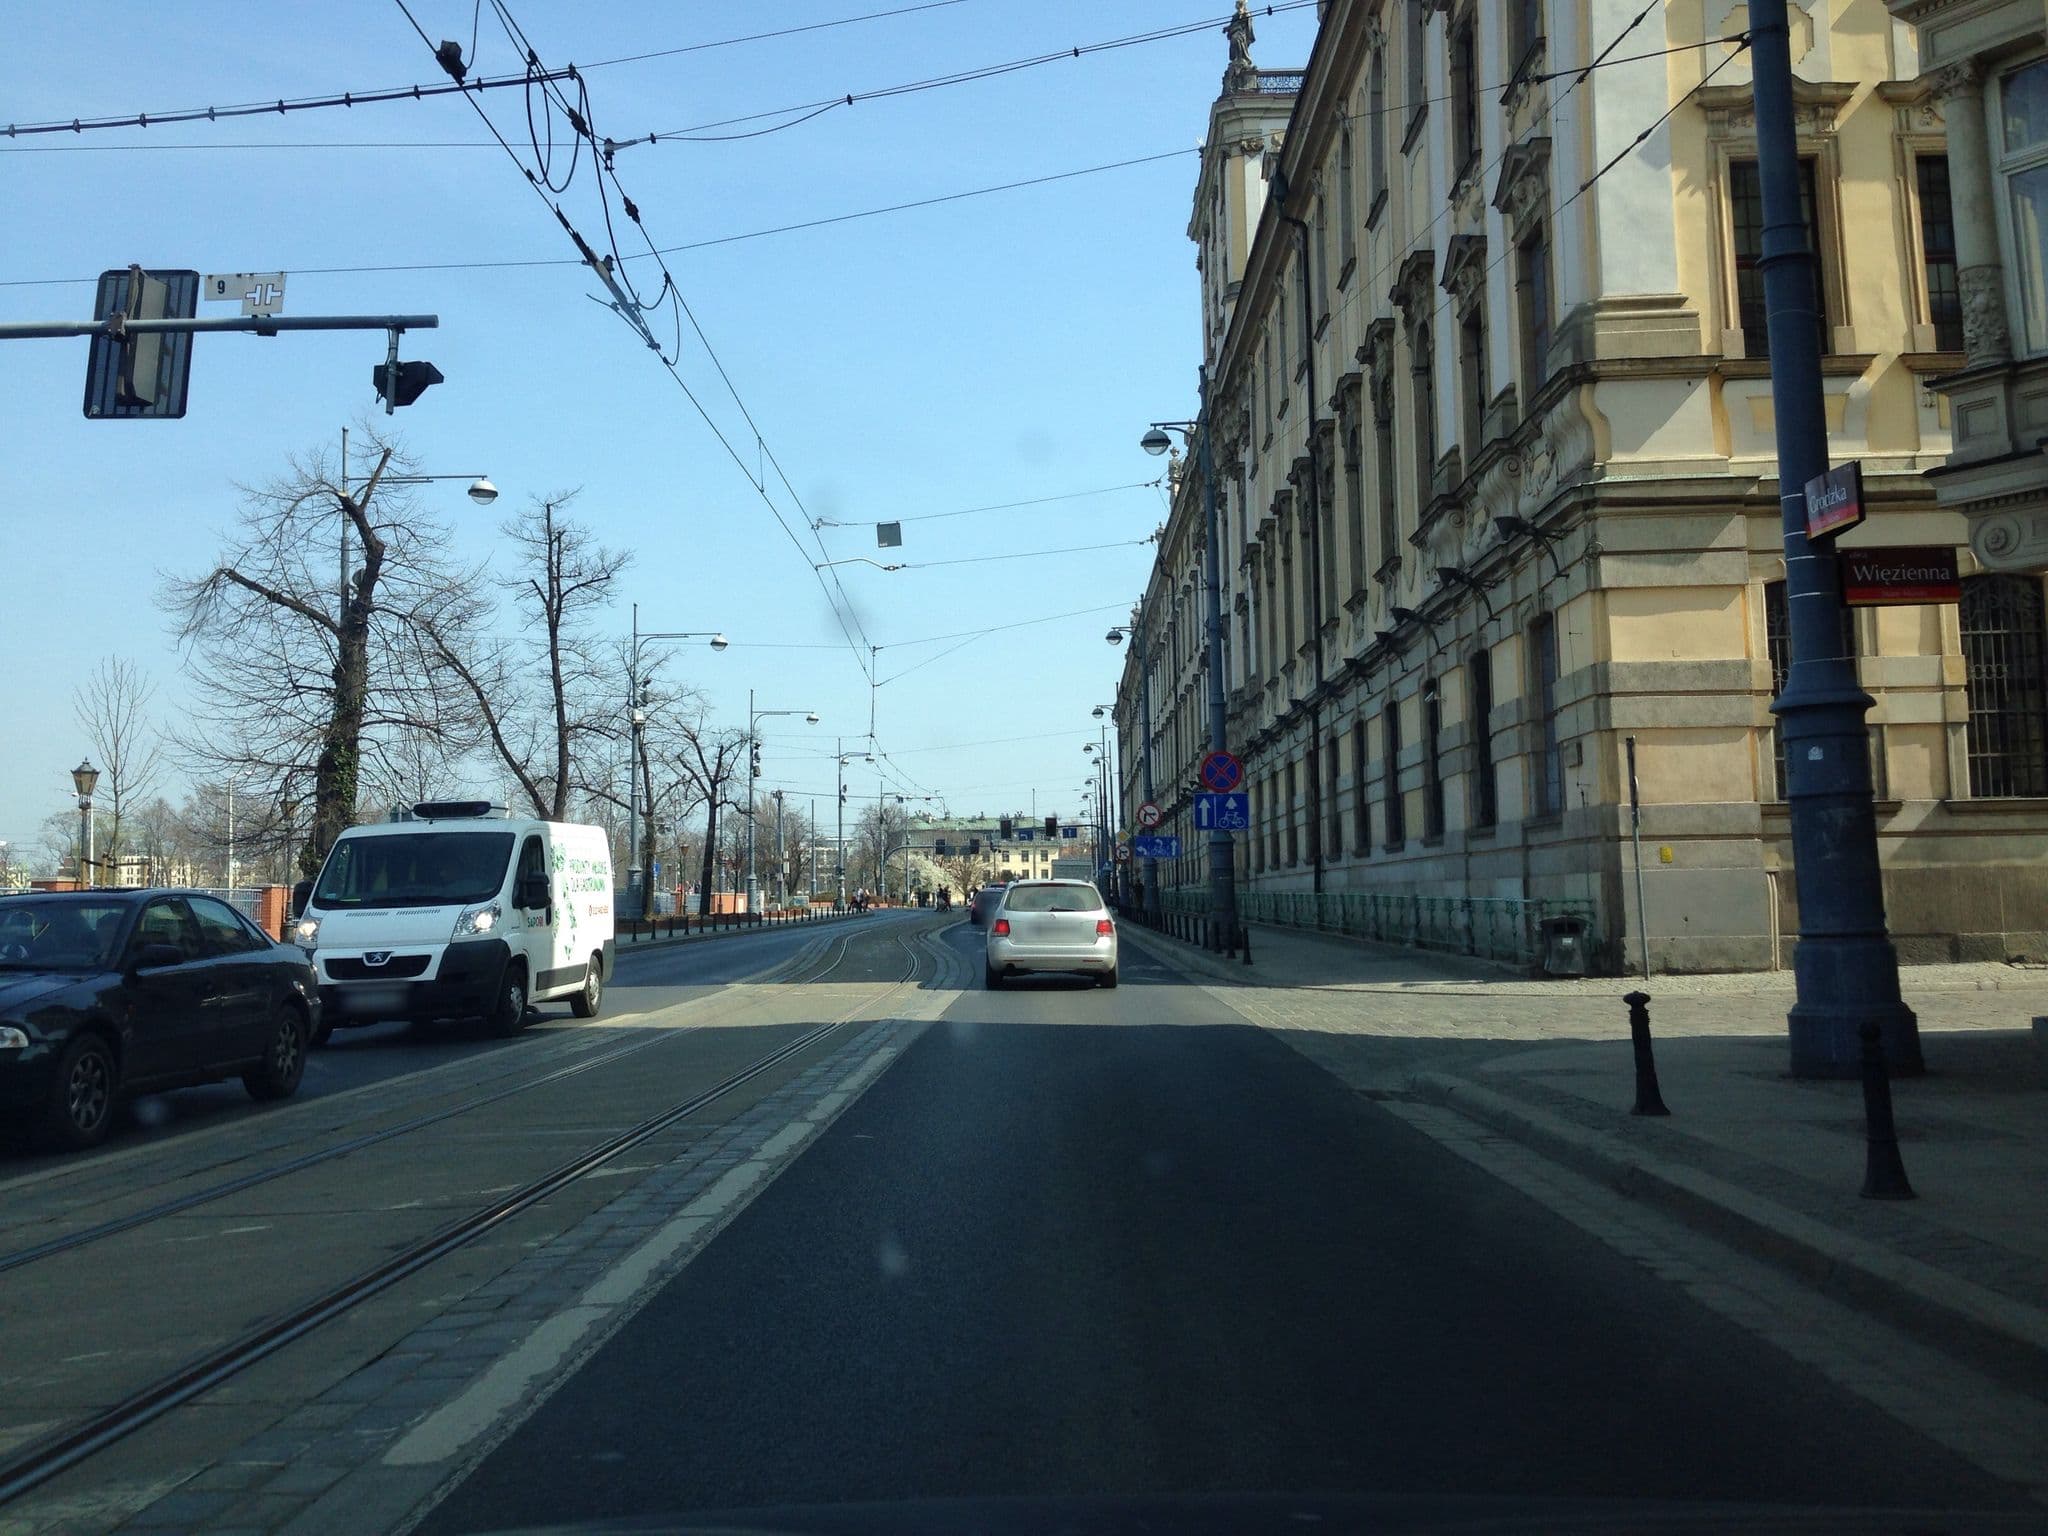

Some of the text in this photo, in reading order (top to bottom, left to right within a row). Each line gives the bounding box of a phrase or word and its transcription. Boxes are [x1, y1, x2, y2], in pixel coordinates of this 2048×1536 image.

[217, 280, 225, 294] 9
[1809, 484, 1847, 513] Grodzka
[1853, 563, 1951, 585] Więzienna
